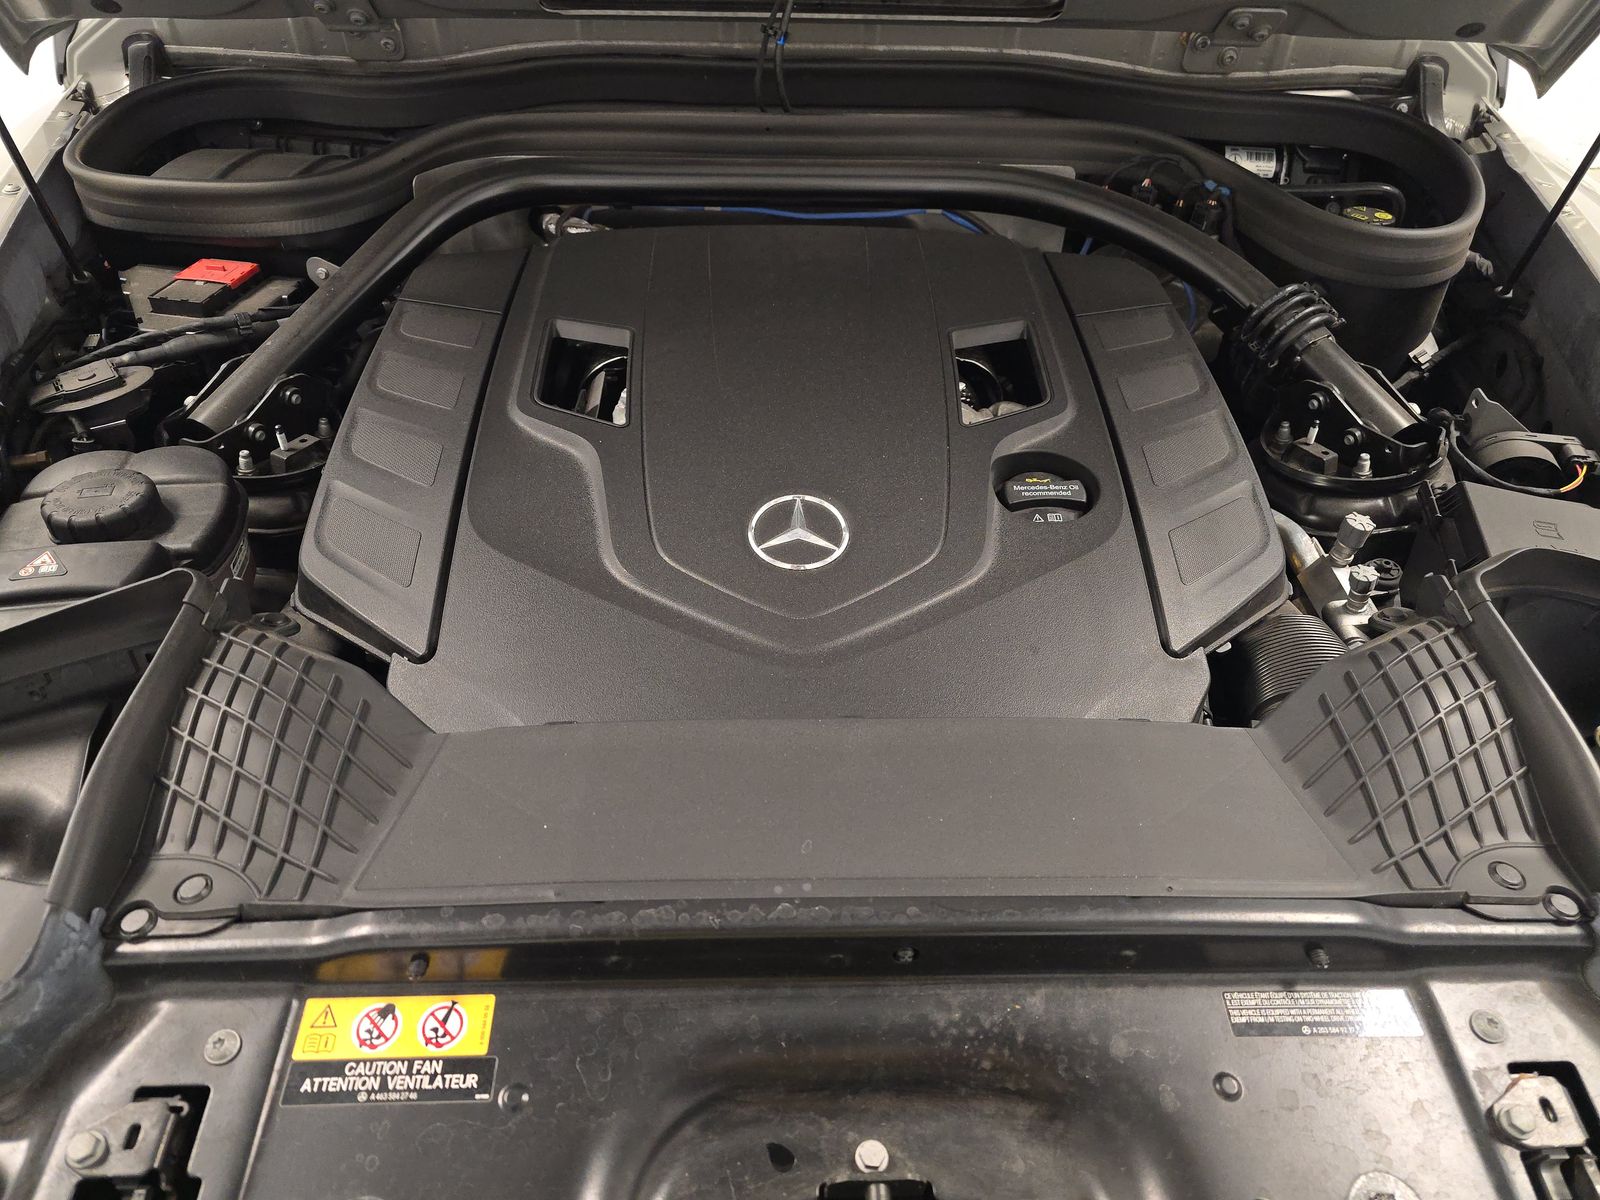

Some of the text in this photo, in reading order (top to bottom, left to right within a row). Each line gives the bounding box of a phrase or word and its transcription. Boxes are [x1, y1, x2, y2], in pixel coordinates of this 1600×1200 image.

[344, 1059, 443, 1076] CAUTION FAN
[299, 1073, 479, 1093] ATTENTION VENTILATEUR
